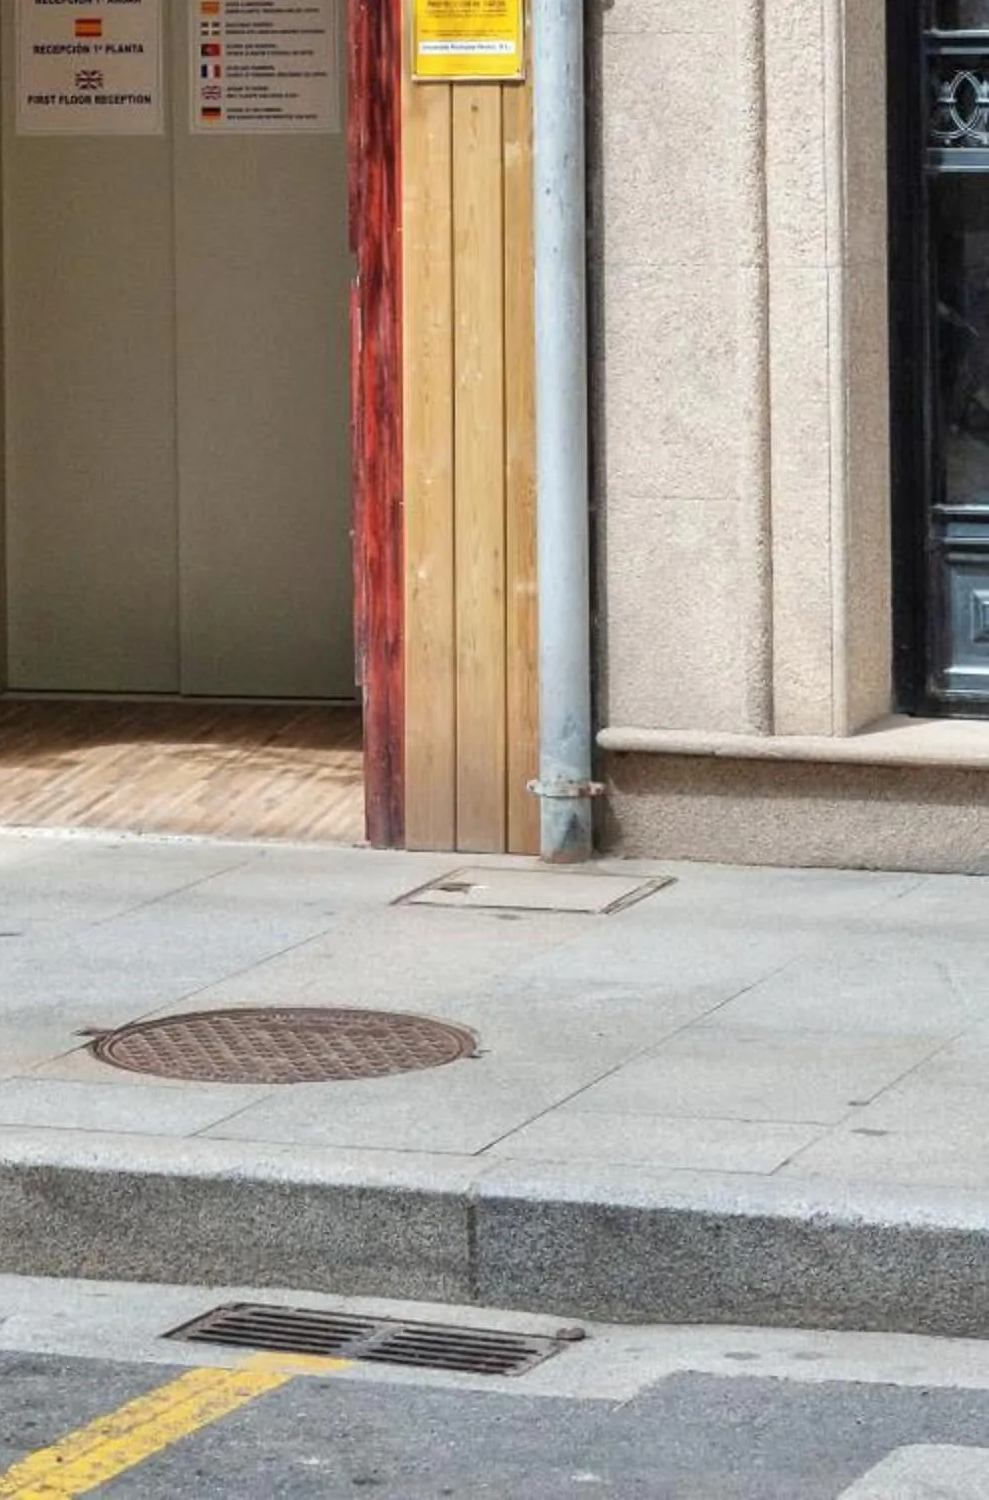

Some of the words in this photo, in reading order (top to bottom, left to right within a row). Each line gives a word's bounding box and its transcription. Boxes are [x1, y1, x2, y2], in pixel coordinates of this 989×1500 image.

[105, 43, 144, 54] PLANTA
[27, 95, 56, 105] FIRST
[58, 94, 91, 104] FLOOR
[94, 94, 152, 105] RECEPTION
